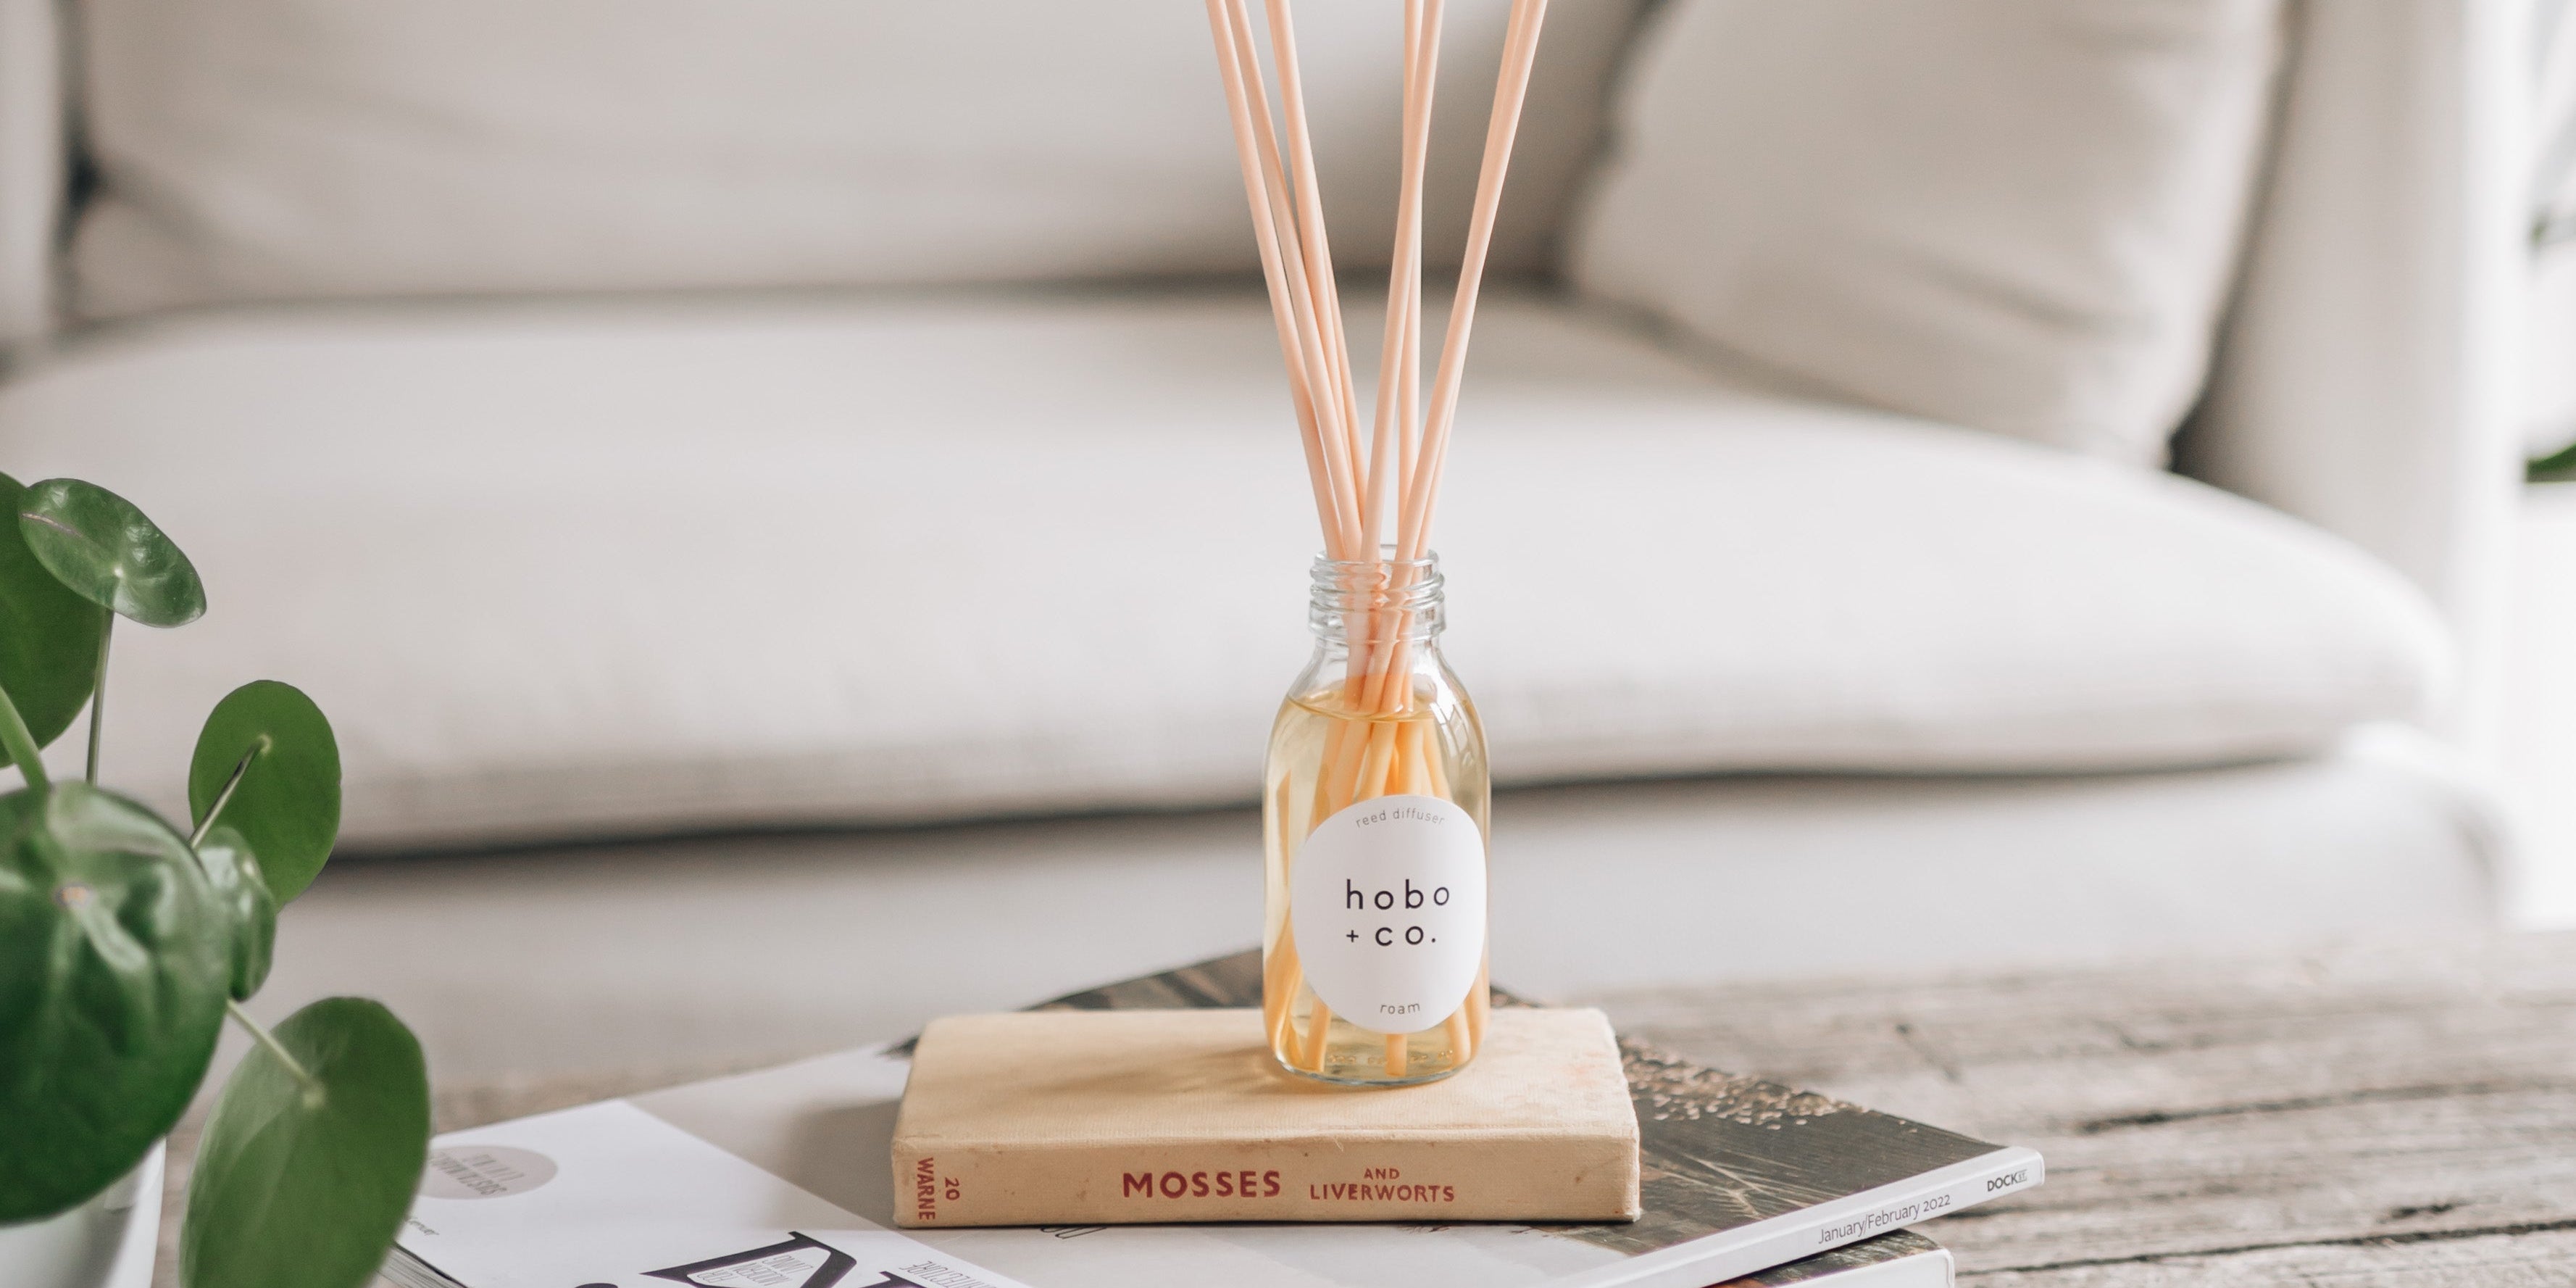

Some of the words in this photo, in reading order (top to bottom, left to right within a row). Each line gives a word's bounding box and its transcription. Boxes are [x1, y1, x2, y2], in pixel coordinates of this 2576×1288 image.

[1356, 809, 1387, 828] reed
[1392, 807, 1446, 826] diffuser
[1346, 878, 1450, 910] hobo
[1375, 925, 1437, 947] co.
[1380, 1002, 1421, 1015] roam
[1122, 1170, 1282, 1199] MOSSES
[1363, 1168, 1401, 1181] AND
[1987, 1172, 2019, 1192] DOCK
[917, 1157, 935, 1220] WARNE
[944, 1176, 961, 1201] 20
[1309, 1183, 1456, 1203] LIVERWORTS
[1817, 1202, 1920, 1245] January/February
[1922, 1194, 1951, 1213] 2022
